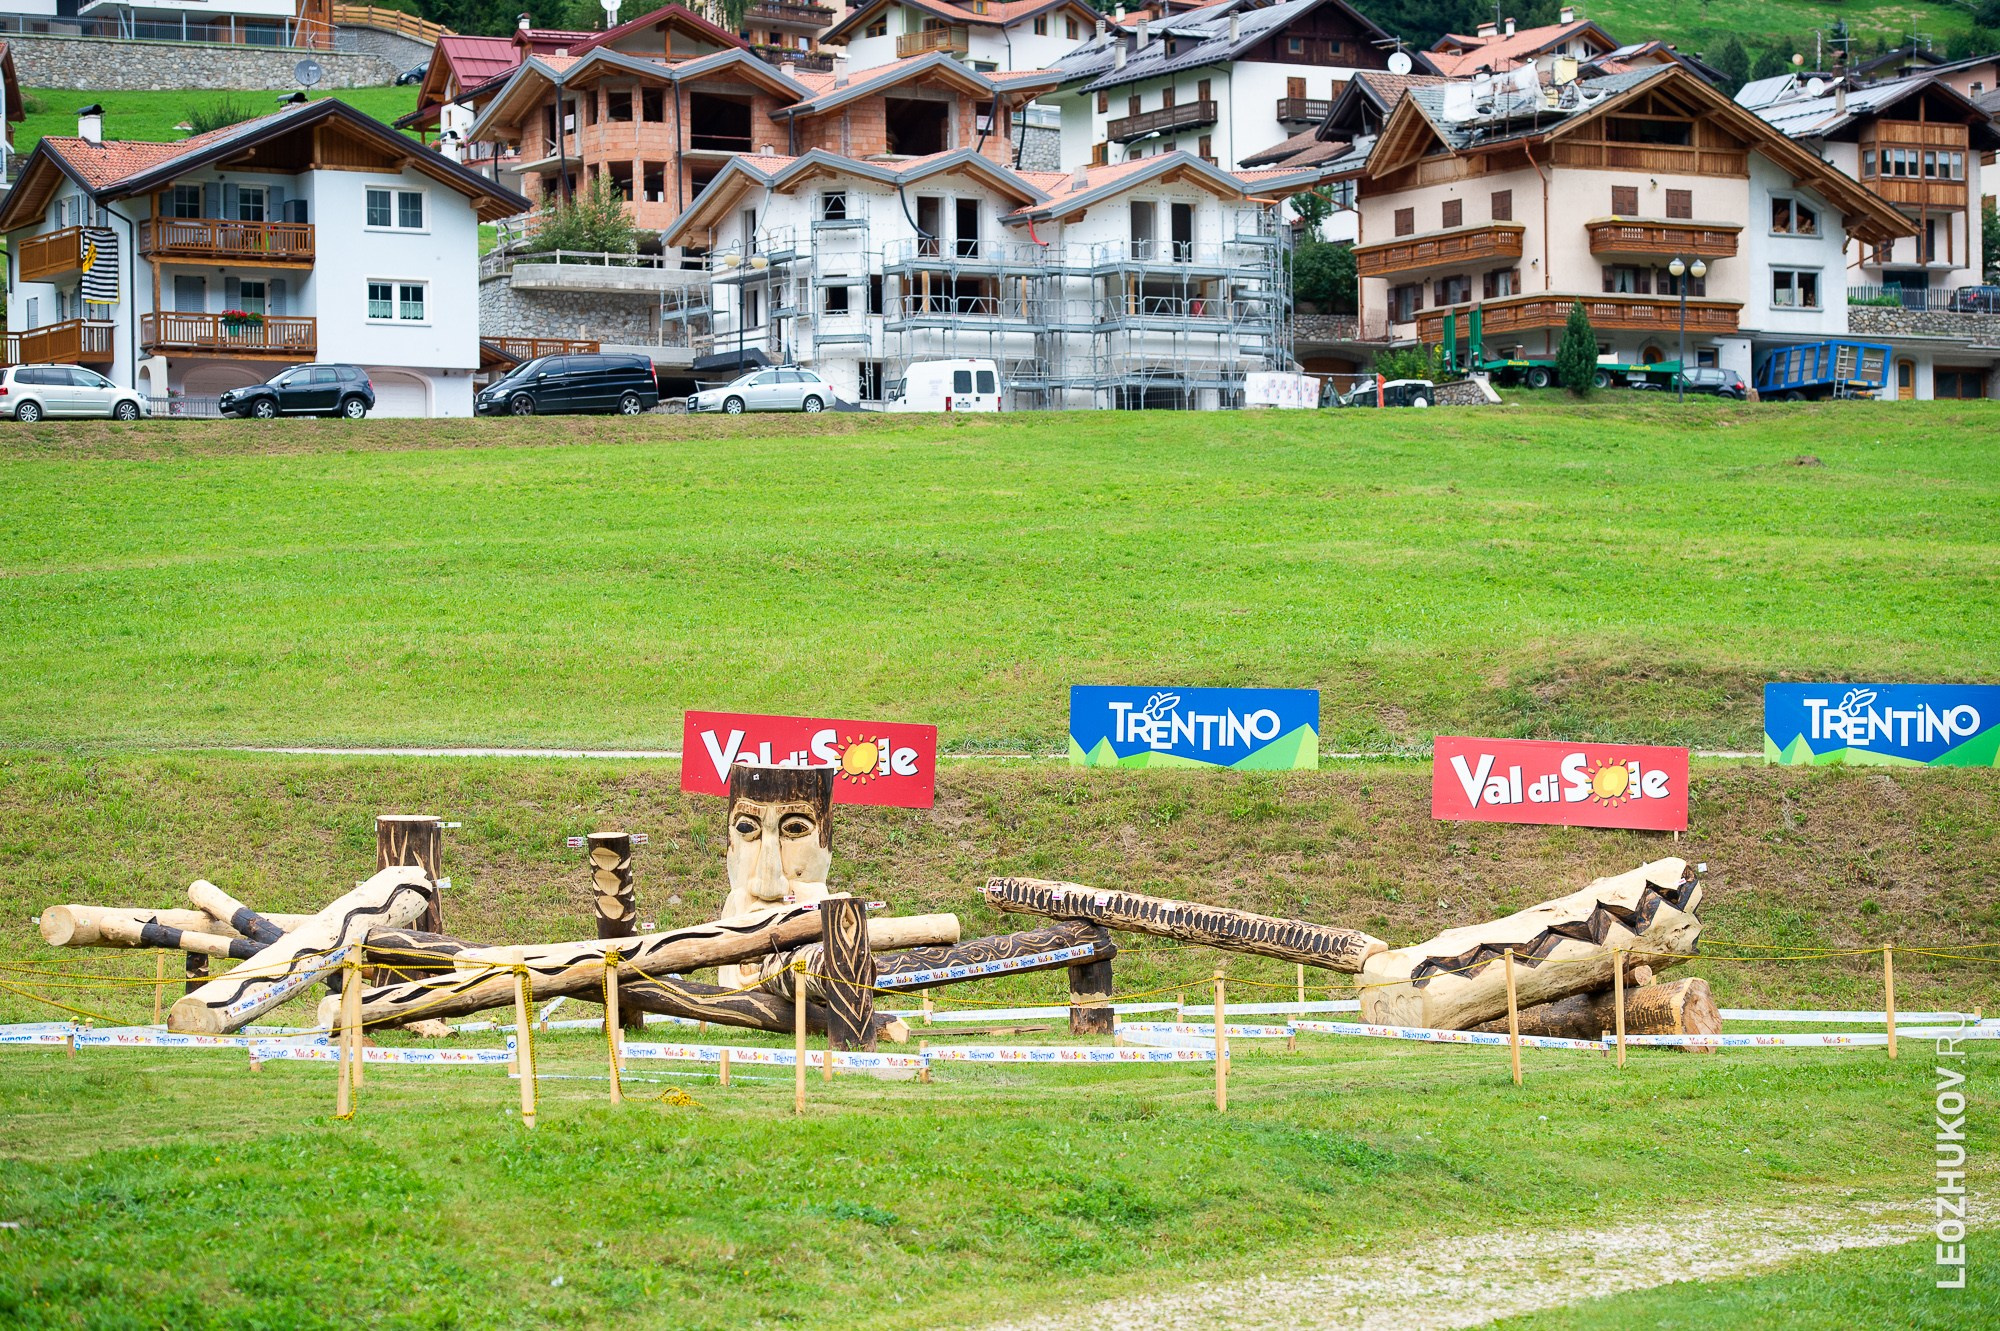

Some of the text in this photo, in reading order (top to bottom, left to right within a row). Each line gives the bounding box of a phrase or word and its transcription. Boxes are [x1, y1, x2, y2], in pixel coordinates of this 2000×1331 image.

[1109, 701, 1281, 751] TRENTINO
[811, 728, 919, 780] Sole
[1450, 752, 1671, 809] Val di Sole
[700, 1049, 720, 1060] TRENTI
[773, 1053, 796, 1063] TRENTIN
